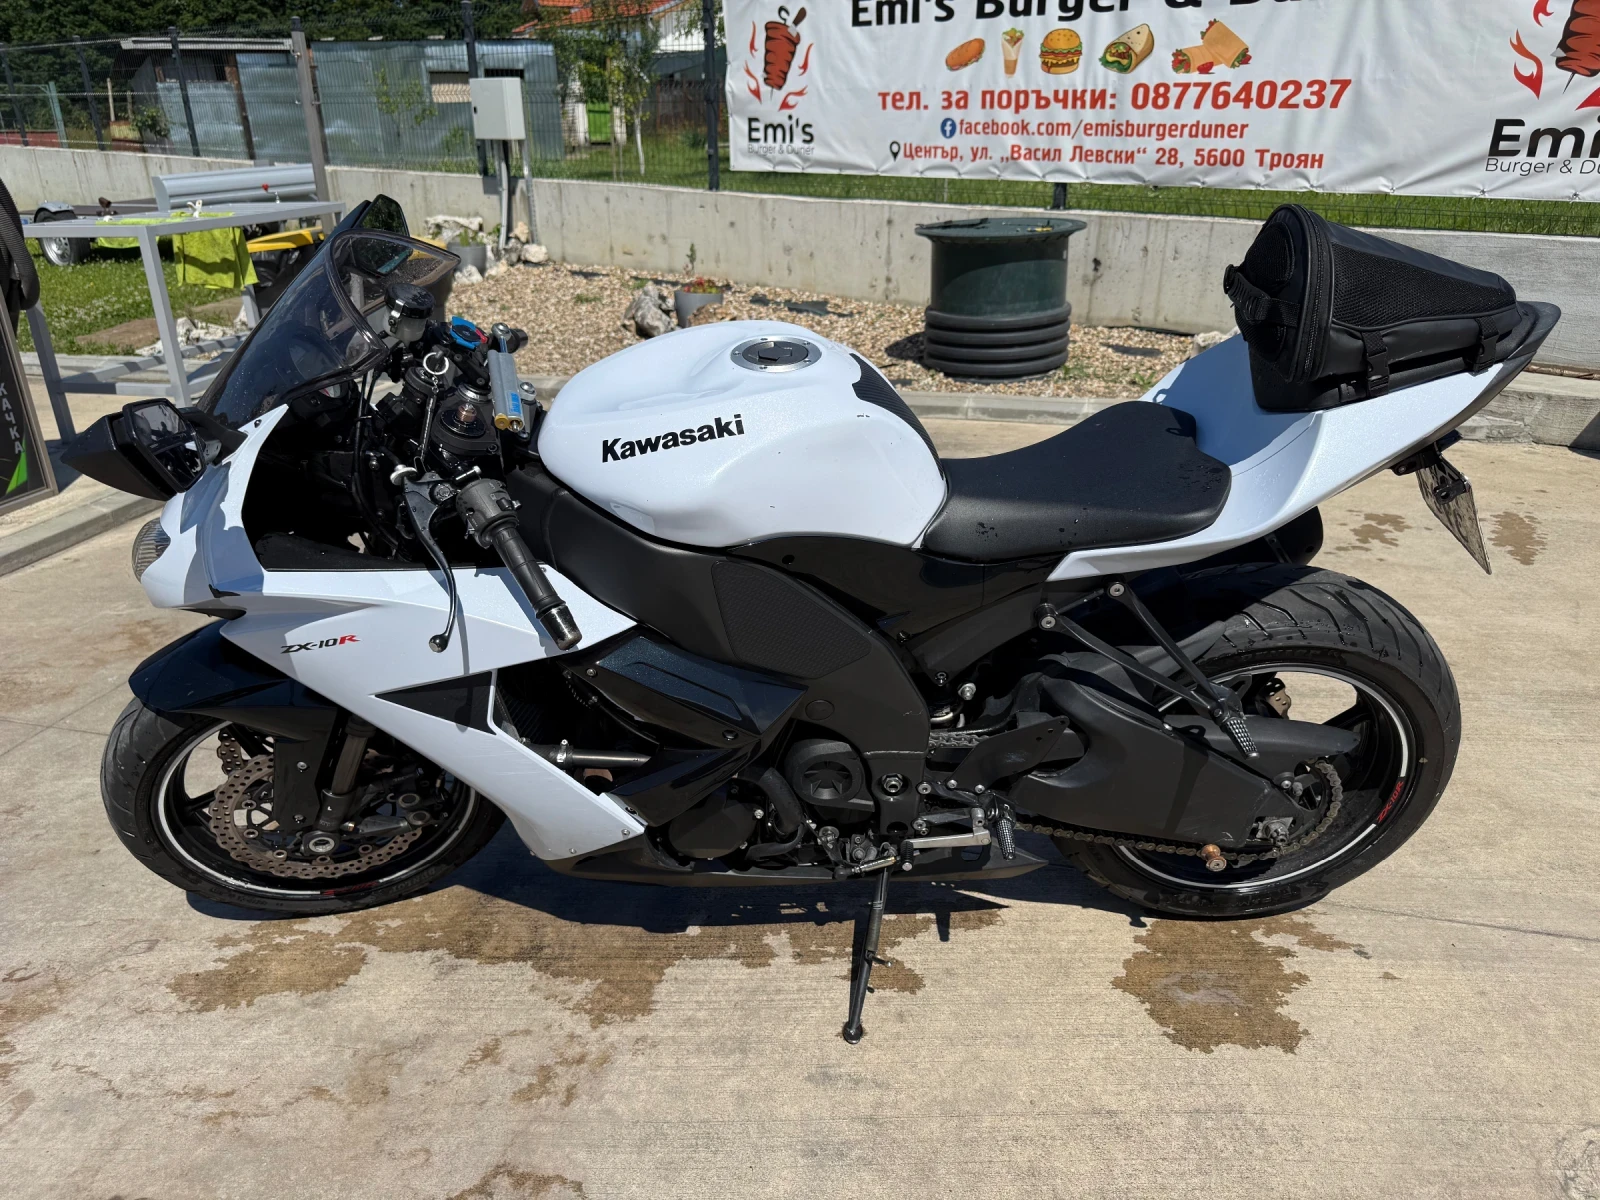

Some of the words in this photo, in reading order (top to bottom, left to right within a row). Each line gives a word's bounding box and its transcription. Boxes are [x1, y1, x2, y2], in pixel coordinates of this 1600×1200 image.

[851, 0, 955, 27] Emis
[878, 91, 929, 110] тел.
[941, 90, 969, 110] за
[981, 88, 1117, 114] поръчки:
[1130, 79, 1352, 110] 0877640237
[748, 114, 815, 144] Emi's
[958, 118, 1249, 142] facebook.com/emisburgerduner
[903, 142, 964, 162] Център,
[970, 145, 993, 162] ул.
[1155, 147, 1184, 168] 28,
[1194, 148, 1245, 167] 5600
[1255, 149, 1324, 171] Троян
[1485, 158, 1554, 177] Burger
[1560, 159, 1573, 174] &
[602, 413, 745, 463] Kawasaki
[280, 634, 361, 655] ZX-10R
